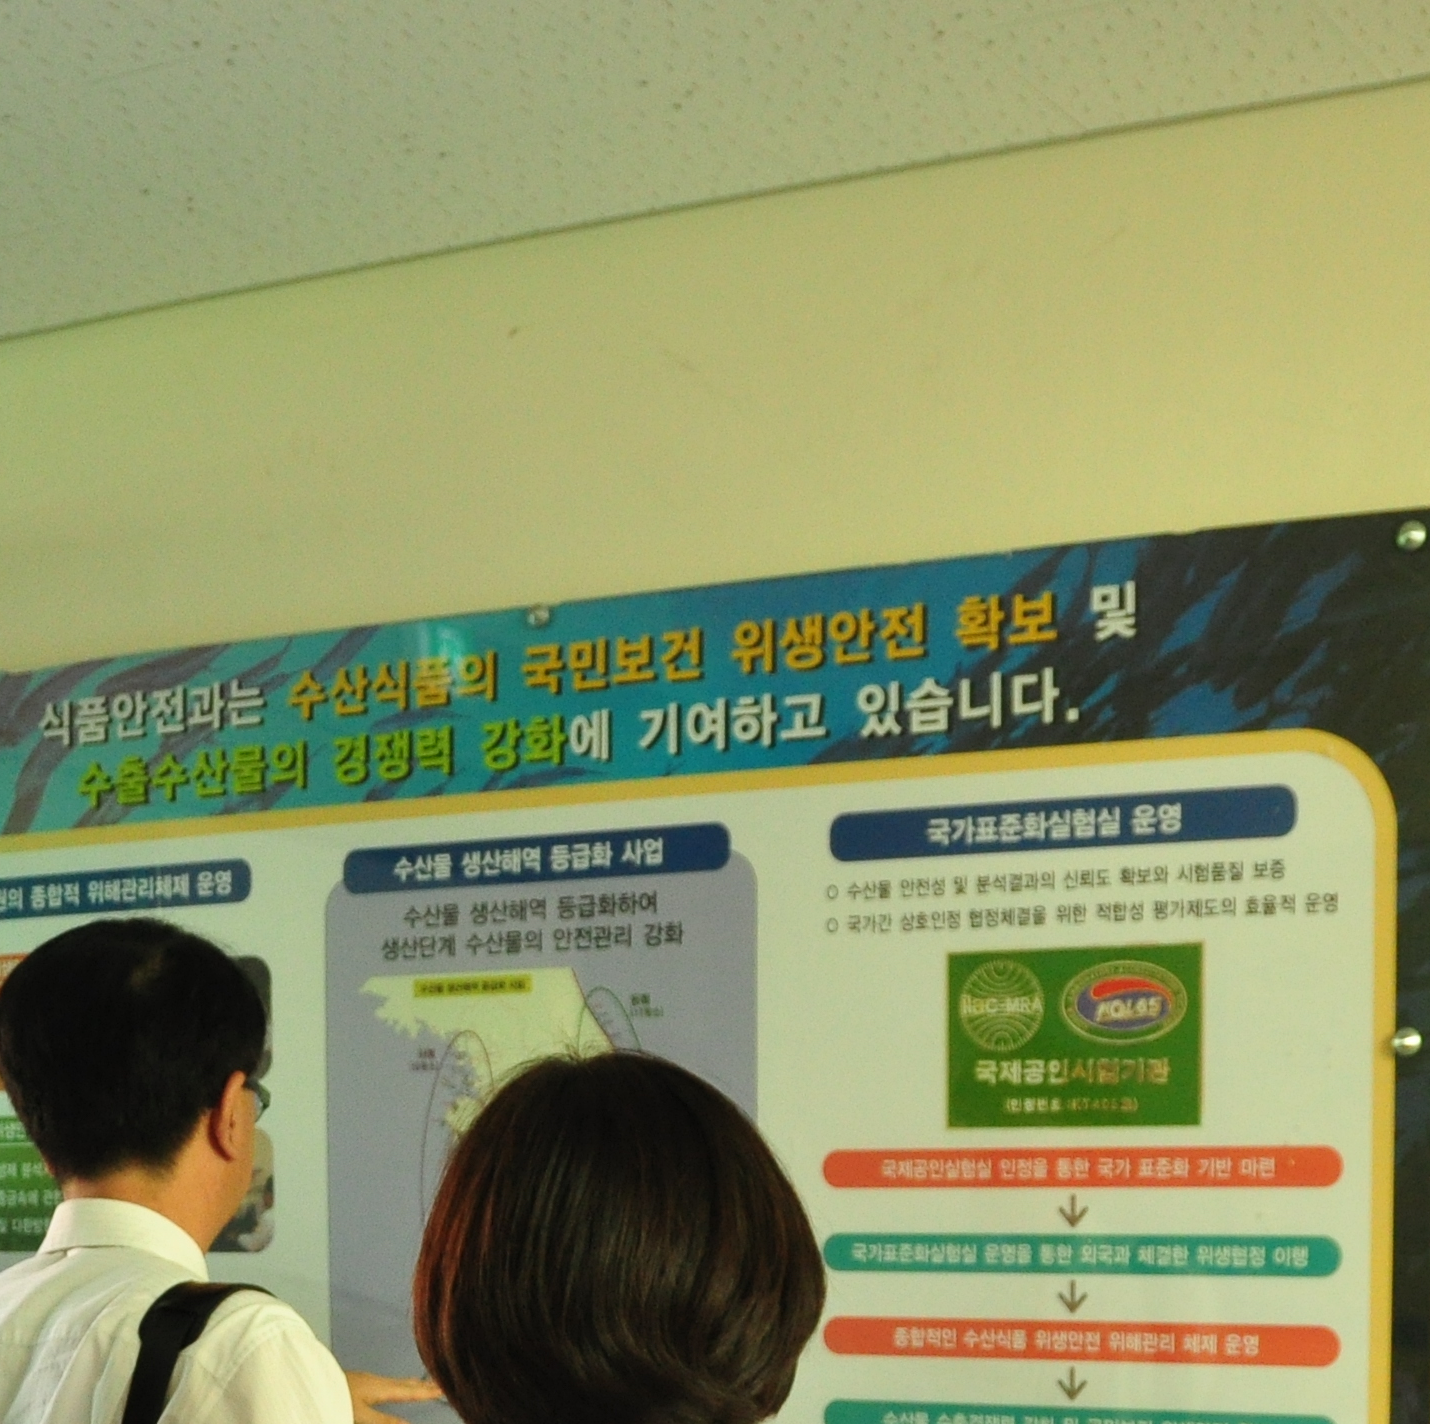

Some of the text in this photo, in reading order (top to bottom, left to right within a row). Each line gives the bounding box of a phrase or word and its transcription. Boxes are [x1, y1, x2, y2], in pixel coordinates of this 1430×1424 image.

[40, 580, 1137, 747] 식품안전과는 수산식품의 국민보건 위생안전 확보 및
[77, 667, 1081, 808] 수출수산물의 경쟁력 강화에 기여하고 있습니다.
[927, 802, 1182, 845] 국가표준화실험실 운영
[393, 837, 664, 883] 수산물 생산해역 등급화 사업
[847, 859, 1285, 900] 수산물 안전성 및 분석결과의 신뢰도 확보와 시험품질 보증
[30, 881, 80, 910] 종합적
[196, 869, 232, 896] 운영
[404, 890, 658, 931] 수산물 생산해역 등급화하여
[847, 892, 1338, 933] 국가간 상호인정 협정체결을 위한 적합성 평가제도의 효율적 운영
[381, 920, 684, 962] 생산단계 수산물의 안전관리 강화
[881, 1157, 1276, 1180] 국제공인실험실 인정을 통한 국가 표준화 기반 마련
[851, 1243, 977, 1263] 국가표준화실험실
[984, 1243, 1032, 1264] 운영을
[1038, 1243, 1073, 1265] 통한
[1081, 1244, 1131, 1265] 외국과
[1197, 1246, 1266, 1267] 위생협정
[1275, 1246, 1309, 1267] 이행
[894, 1327, 1259, 1356] 종합적인 수산식품 위생안전 위해관리 체제 운영
